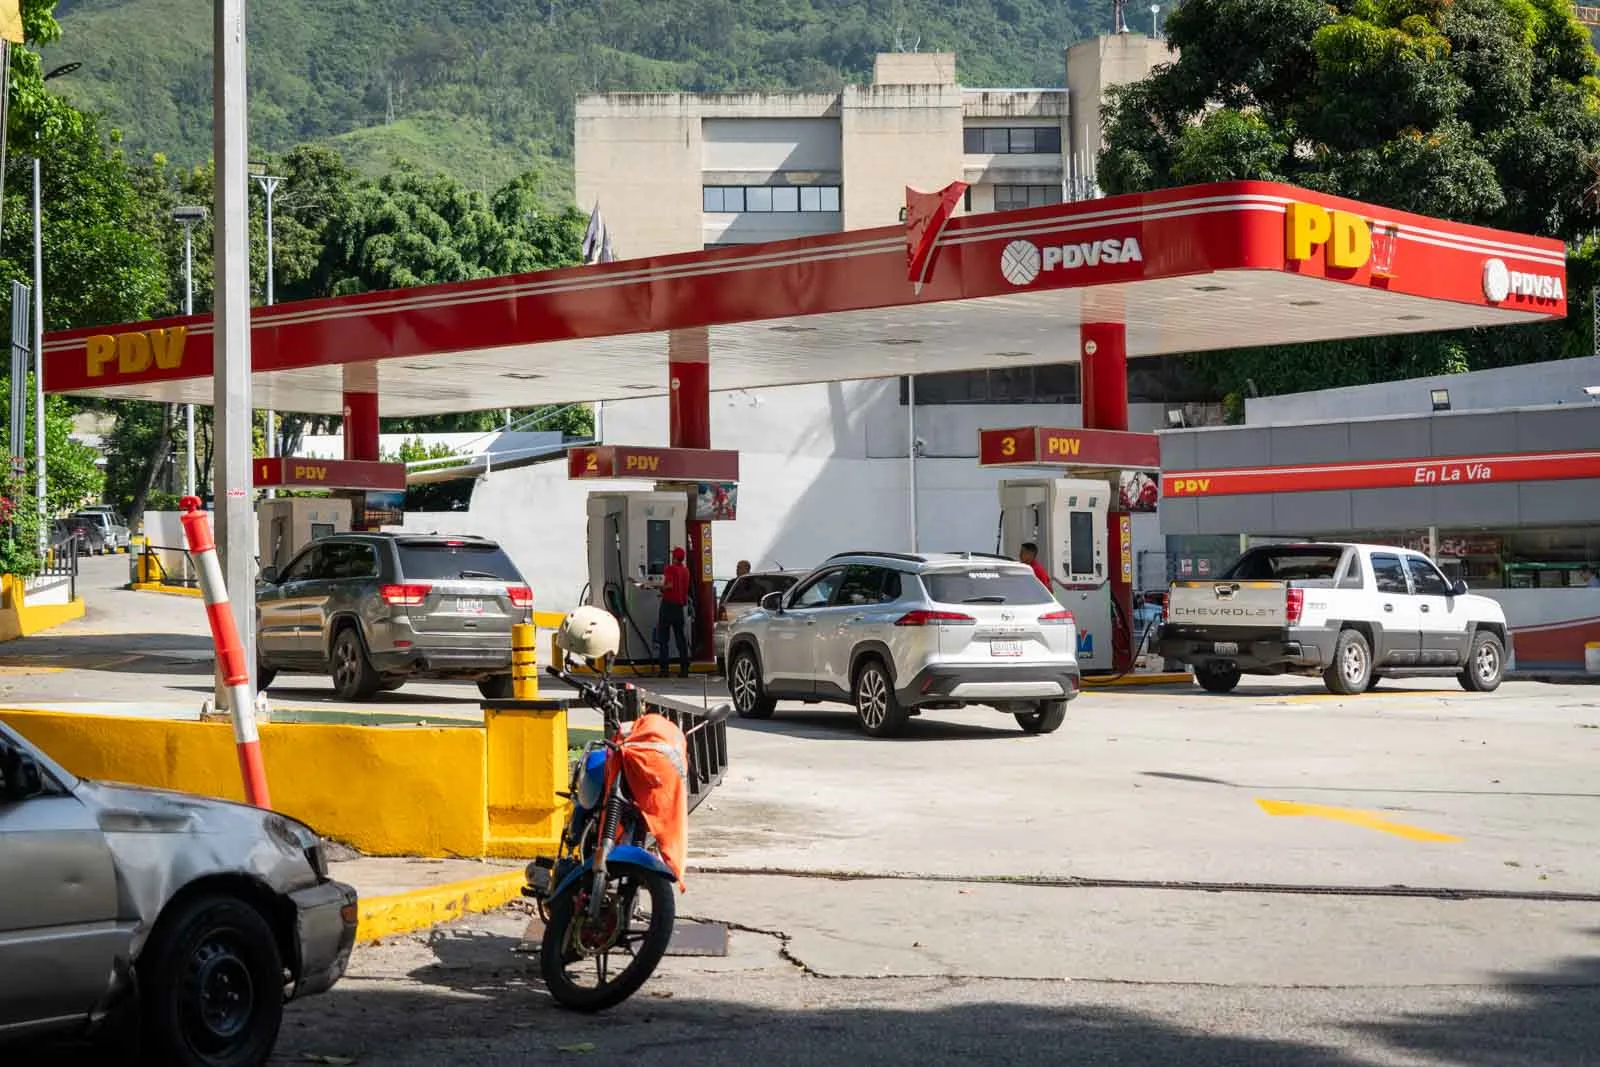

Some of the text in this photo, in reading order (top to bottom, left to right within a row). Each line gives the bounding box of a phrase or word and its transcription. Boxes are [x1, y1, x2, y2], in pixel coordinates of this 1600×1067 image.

[1042, 237, 1142, 271] PDVSA
[1511, 270, 1564, 299] PDVSA
[86, 325, 188, 377] PDV
[1002, 436, 1016, 456] 3
[1048, 437, 1081, 455] PDV
[586, 453, 598, 470] 2
[626, 455, 660, 471] PDV
[261, 465, 269, 480] 1
[295, 465, 328, 480] PDV
[1414, 463, 1491, 482] En La Vía
[1174, 479, 1210, 493] PDV
[1175, 607, 1278, 616] CHEVROLET
